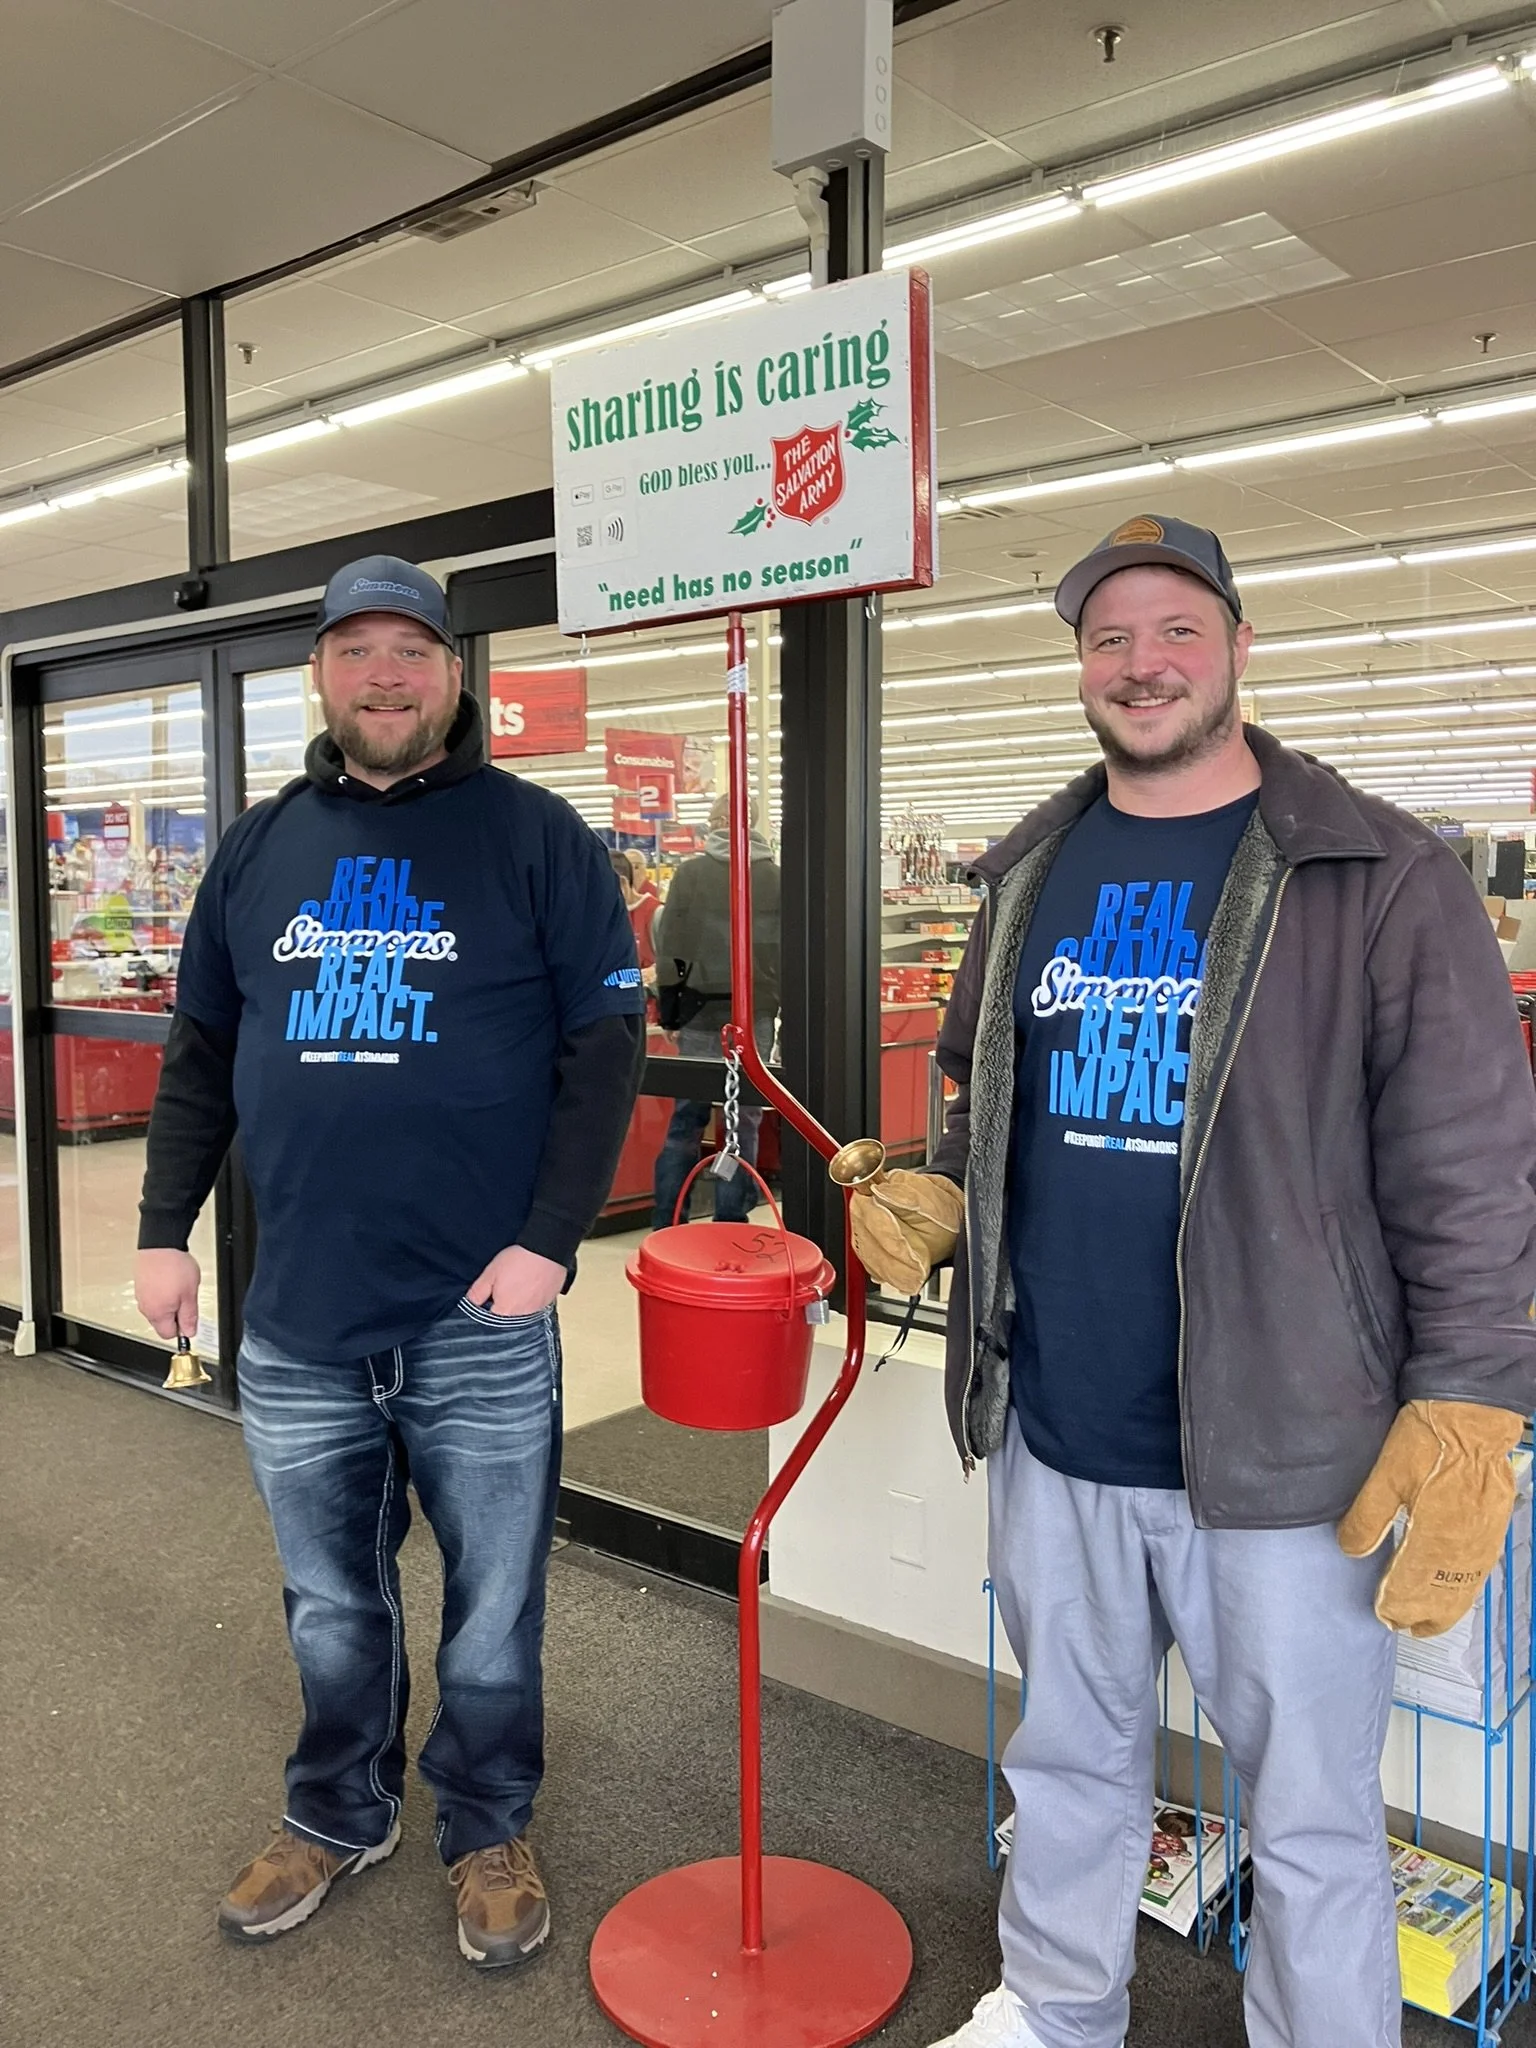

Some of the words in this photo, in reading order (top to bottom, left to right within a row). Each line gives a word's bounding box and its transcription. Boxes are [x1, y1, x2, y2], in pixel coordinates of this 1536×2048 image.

[566, 368, 703, 452] sharing
[714, 360, 744, 418] is
[756, 318, 891, 406] caring
[639, 469, 673, 496] GOD
[678, 460, 718, 488] bless
[723, 453, 772, 484] you...
[776, 433, 837, 507] SALVATION
[782, 434, 811, 471] THE
[798, 464, 836, 514] ARMY
[349, 577, 421, 600] Simmons
[674, 573, 714, 601] has
[722, 568, 753, 593] no
[104, 813, 114, 824] DO
[115, 812, 129, 824] NOT
[639, 785, 661, 808] 2
[329, 855, 413, 902] REAL
[1091, 880, 1197, 943] REAL
[273, 914, 456, 962] Simmons
[1053, 936, 1208, 980] CHANG
[315, 944, 413, 994] REAL
[285, 989, 439, 1043] IMPACT.
[1077, 995, 1190, 1065] REAL
